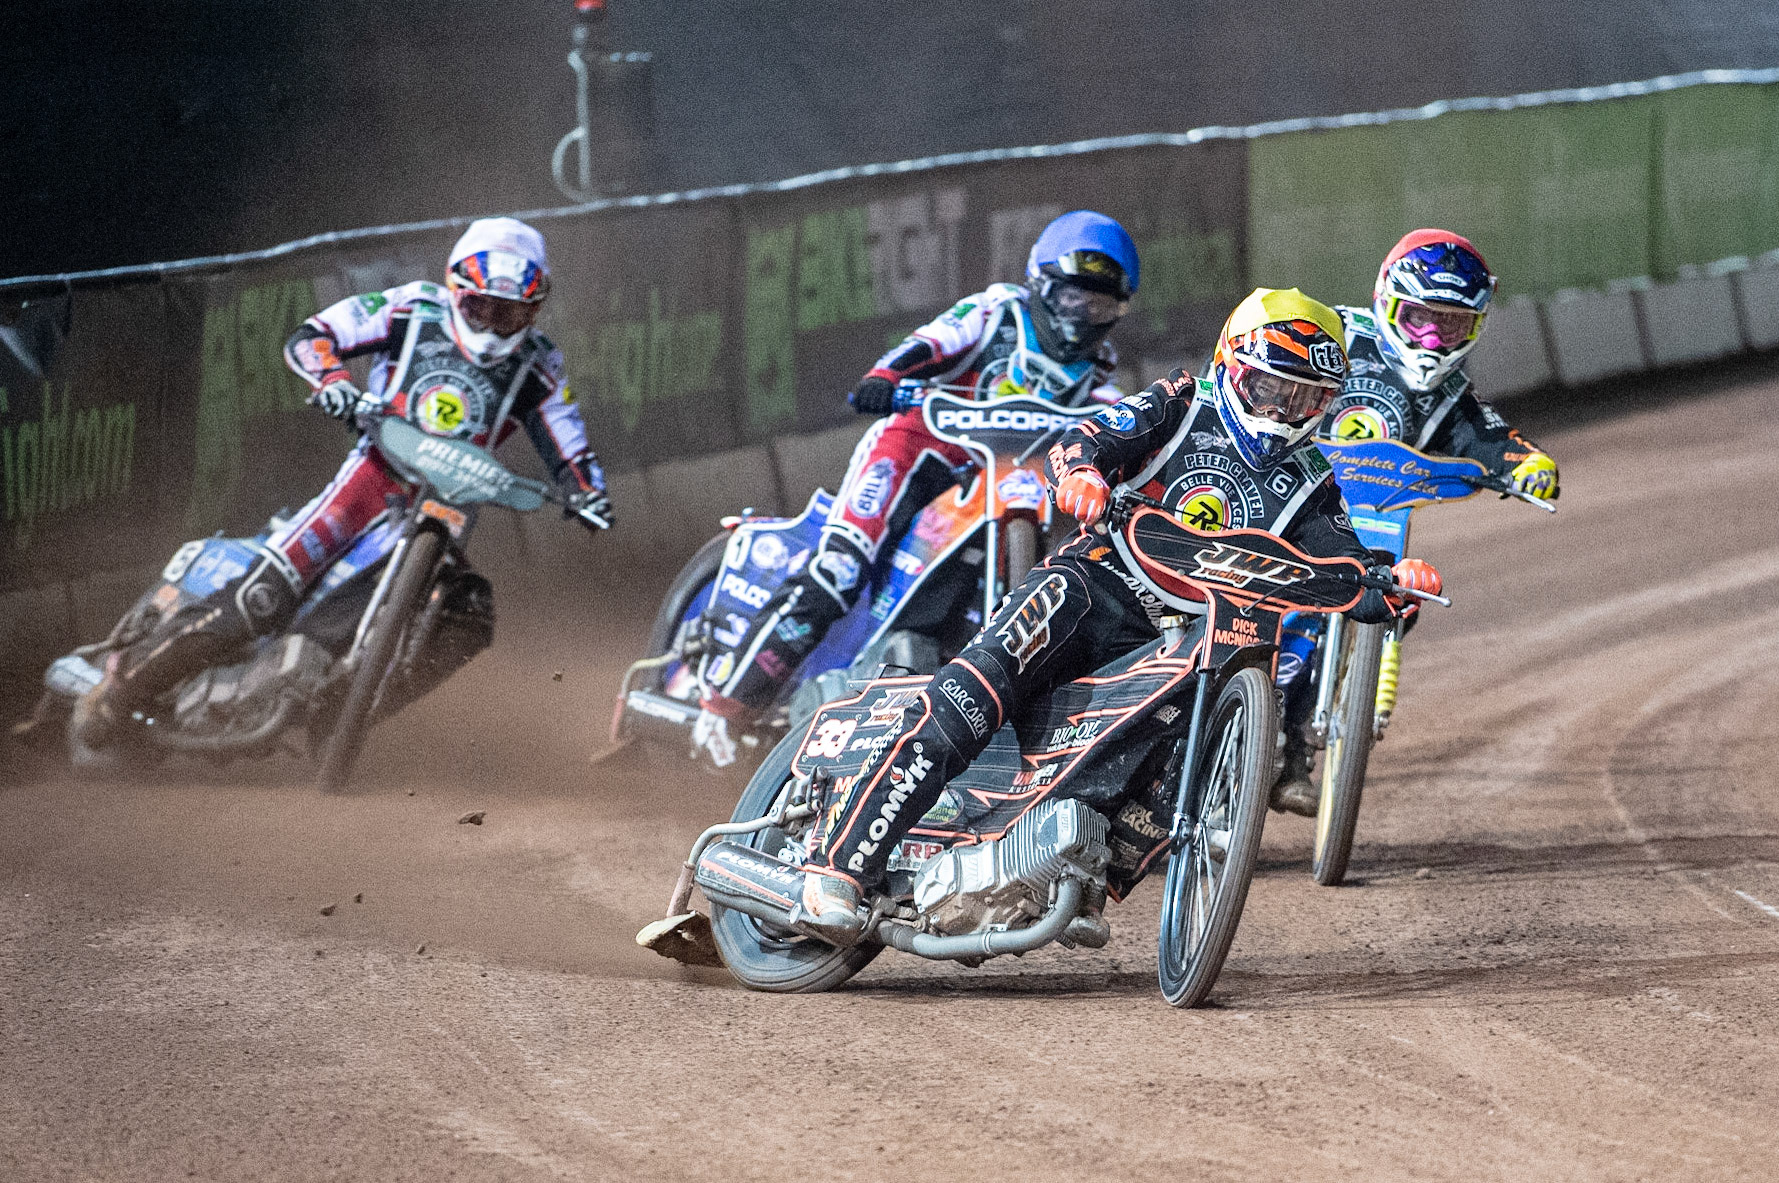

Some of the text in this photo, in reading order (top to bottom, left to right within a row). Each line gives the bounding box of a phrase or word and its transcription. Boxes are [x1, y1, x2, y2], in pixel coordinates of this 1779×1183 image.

[937, 410, 1083, 433] POLCOPP
[1326, 450, 1397, 471] Complete
[1400, 460, 1432, 477] Car
[1184, 452, 1230, 472] PETER
[1229, 462, 1265, 520] CRAVEN
[1271, 473, 1293, 495] 6
[1340, 467, 1404, 489] Services
[1180, 475, 1242, 530] BELLE VUE ACES
[1200, 566, 1251, 585] racing
[1232, 618, 1258, 636] DICK
[942, 678, 990, 739] GARCAREK
[805, 718, 859, 759] 33
